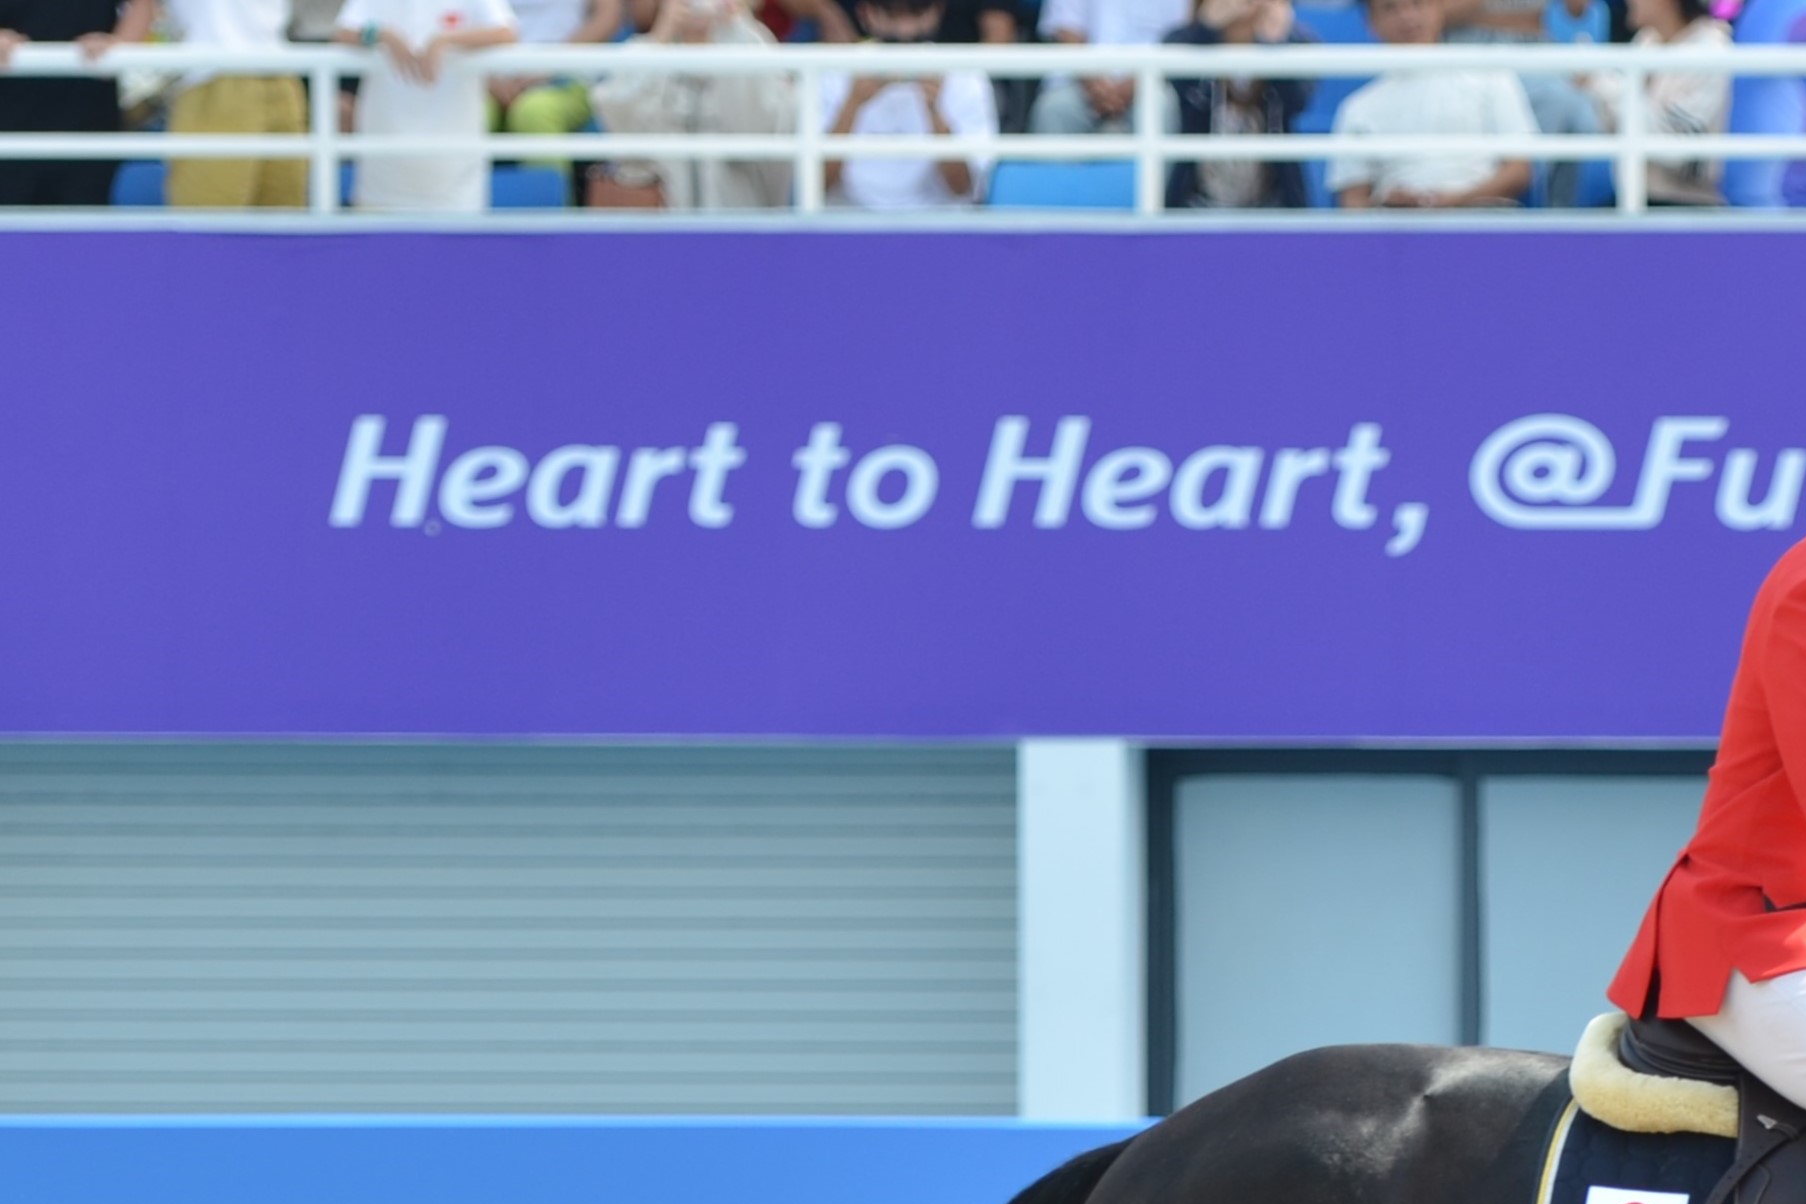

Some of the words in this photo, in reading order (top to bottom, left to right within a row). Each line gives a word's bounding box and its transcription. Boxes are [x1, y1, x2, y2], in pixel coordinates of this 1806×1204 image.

[328, 414, 746, 528] Heart
[792, 422, 940, 529] to
[972, 415, 1429, 556] Heart,
